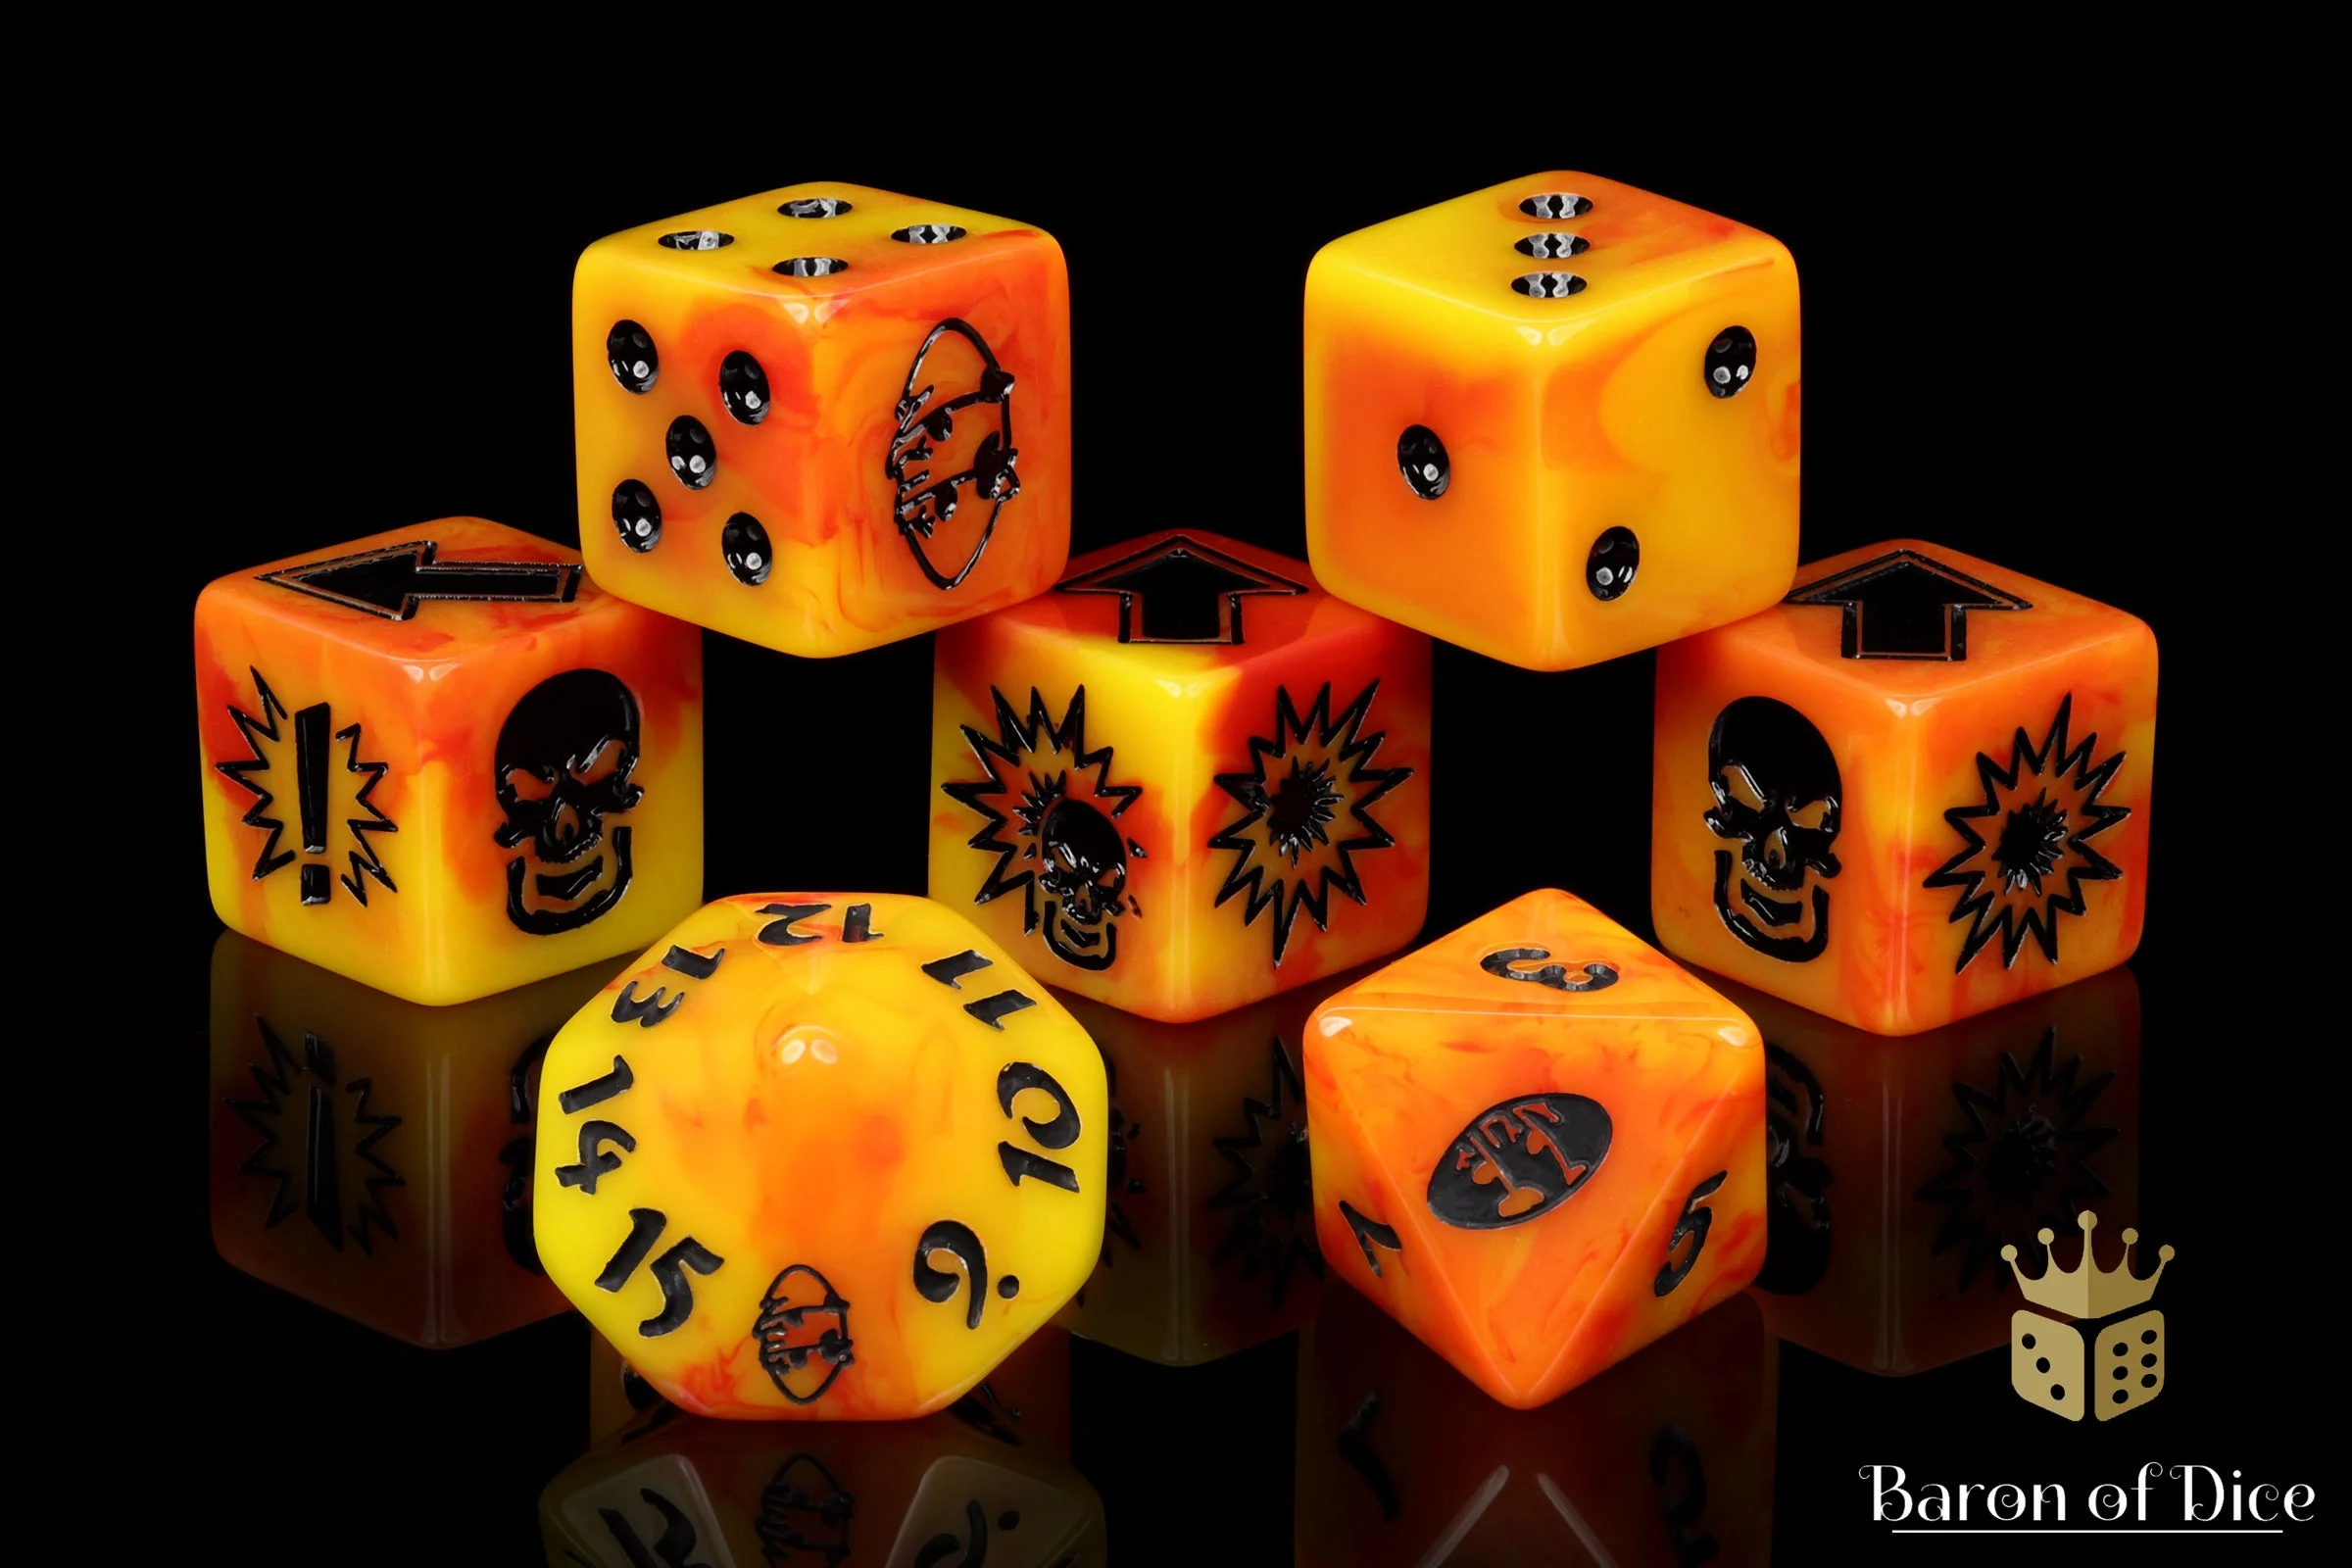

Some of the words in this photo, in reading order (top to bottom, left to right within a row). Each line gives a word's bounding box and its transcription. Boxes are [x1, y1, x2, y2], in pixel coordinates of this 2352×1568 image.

[756, 903, 884, 946] 12
[1480, 947, 1620, 993] 3
[612, 944, 726, 1028] 13
[921, 949, 1038, 1031] 11
[555, 1054, 638, 1196] 14
[996, 1061, 1082, 1195] 10
[594, 1207, 725, 1340] 15
[1653, 1168, 1729, 1298] 5
